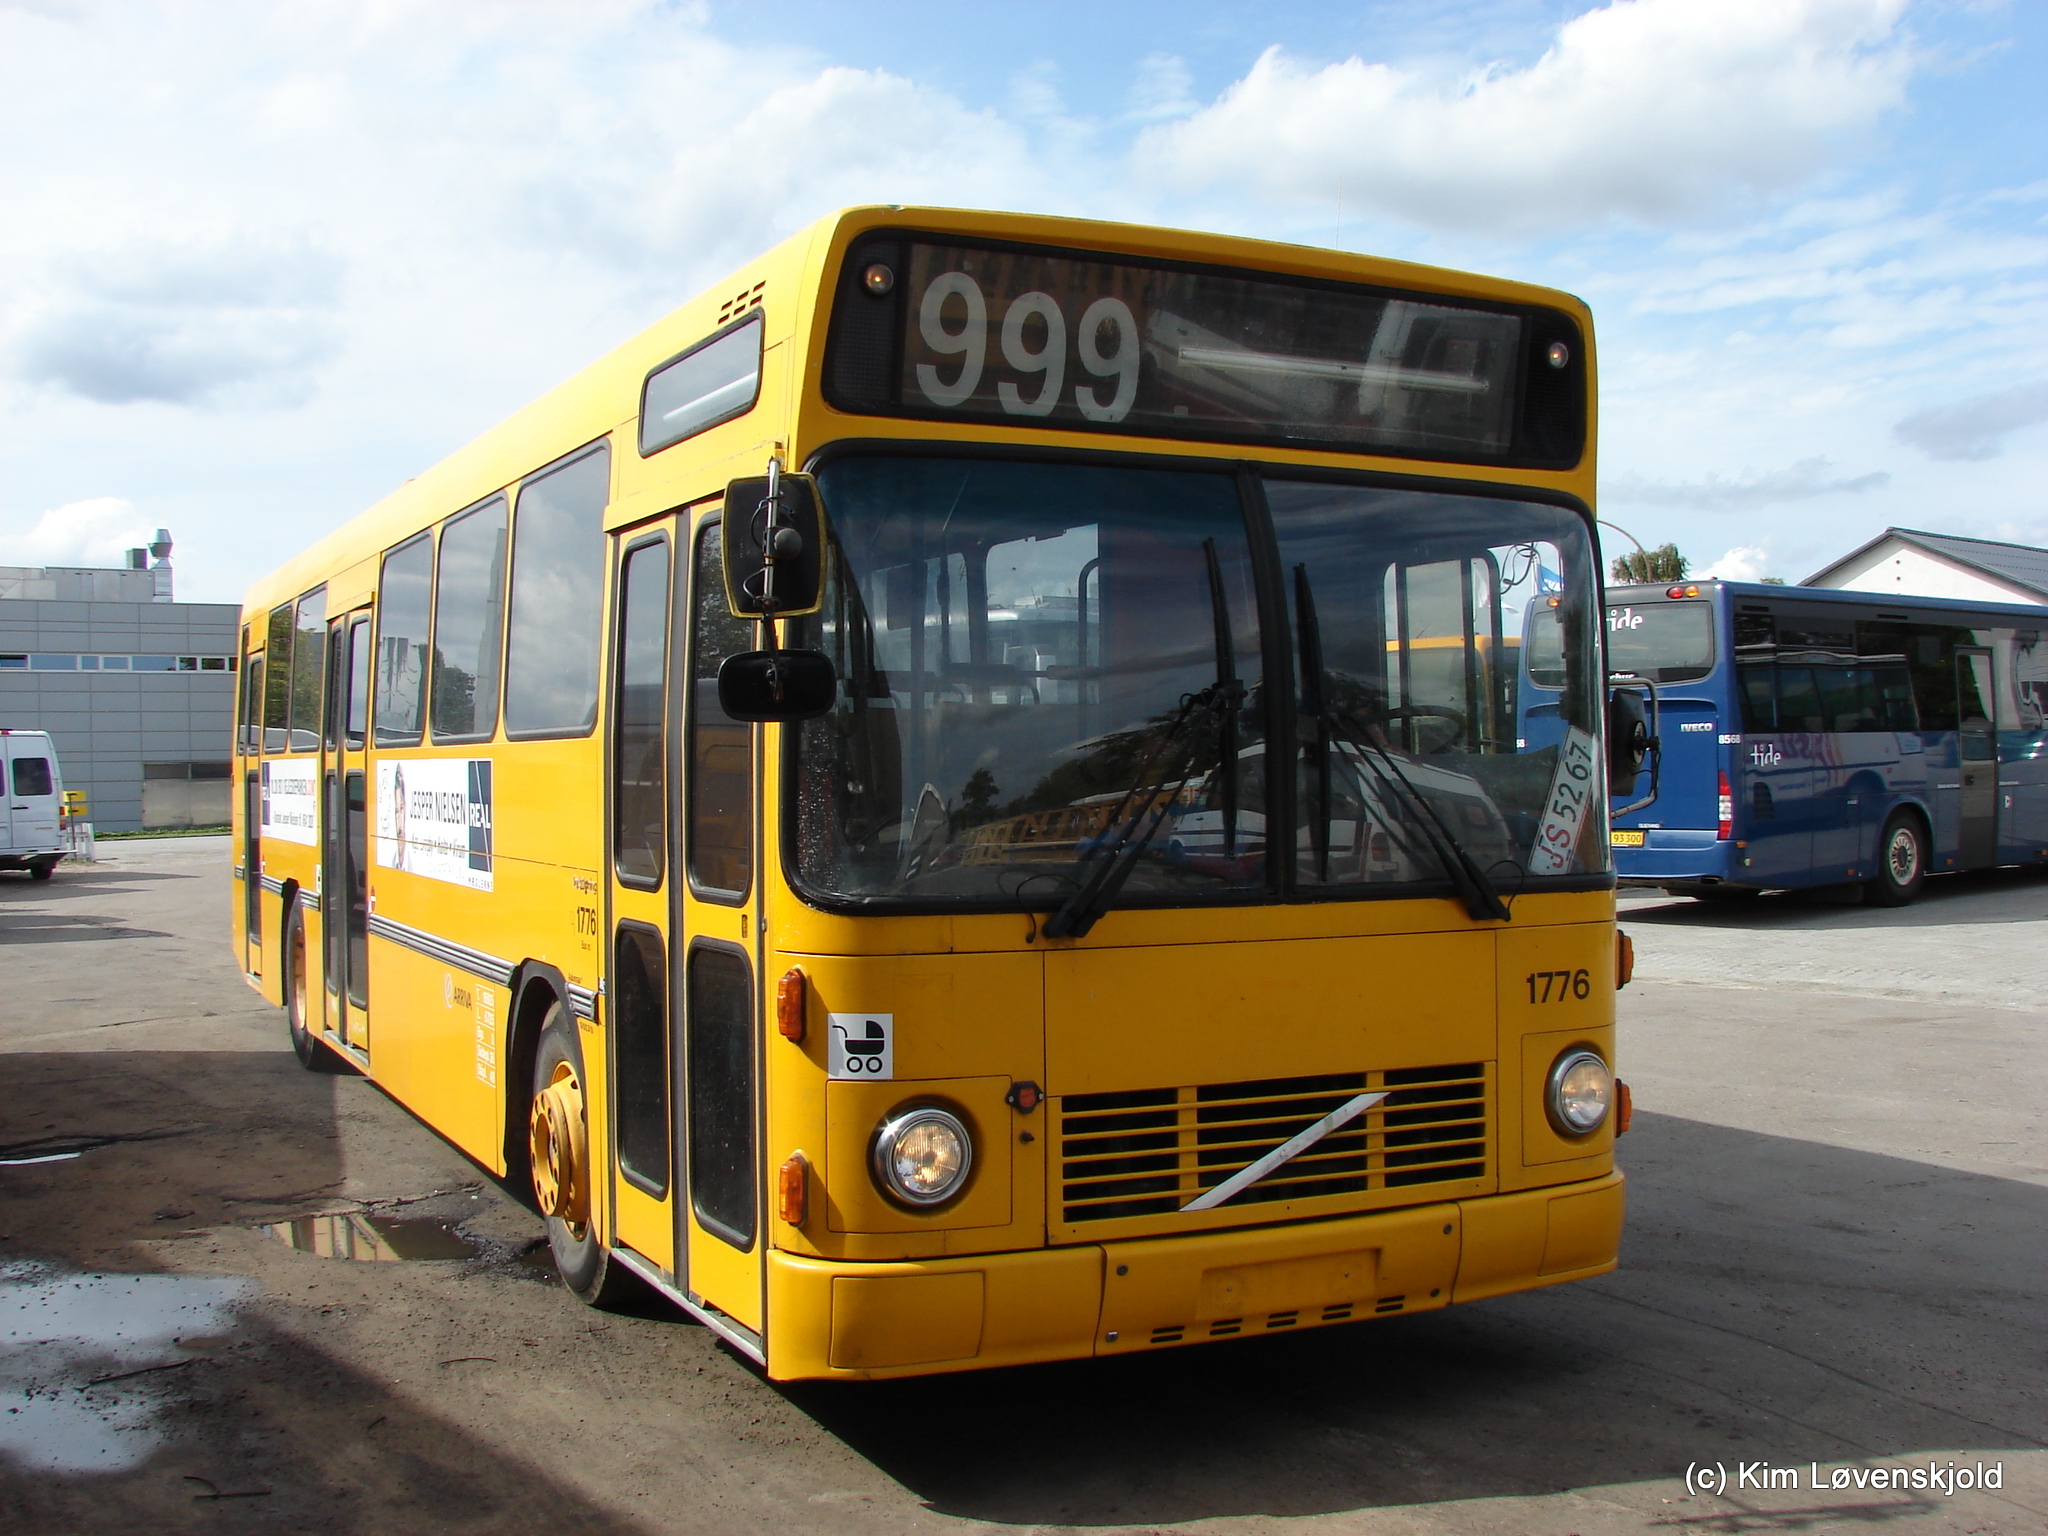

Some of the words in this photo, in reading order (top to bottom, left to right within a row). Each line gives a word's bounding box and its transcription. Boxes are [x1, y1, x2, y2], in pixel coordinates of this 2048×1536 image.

[915, 271, 1141, 424] 999
[1605, 606, 1644, 632] ide
[1680, 722, 1713, 733] IVECO
[1717, 733, 1741, 745] 8568
[1750, 743, 1782, 767] tide
[410, 790, 434, 821] JESPER
[435, 791, 466, 825] NIELSEN
[469, 802, 491, 829] REAL
[1539, 823, 1571, 869] JS
[576, 905, 597, 936] 1776
[1525, 968, 1591, 1004] 1776
